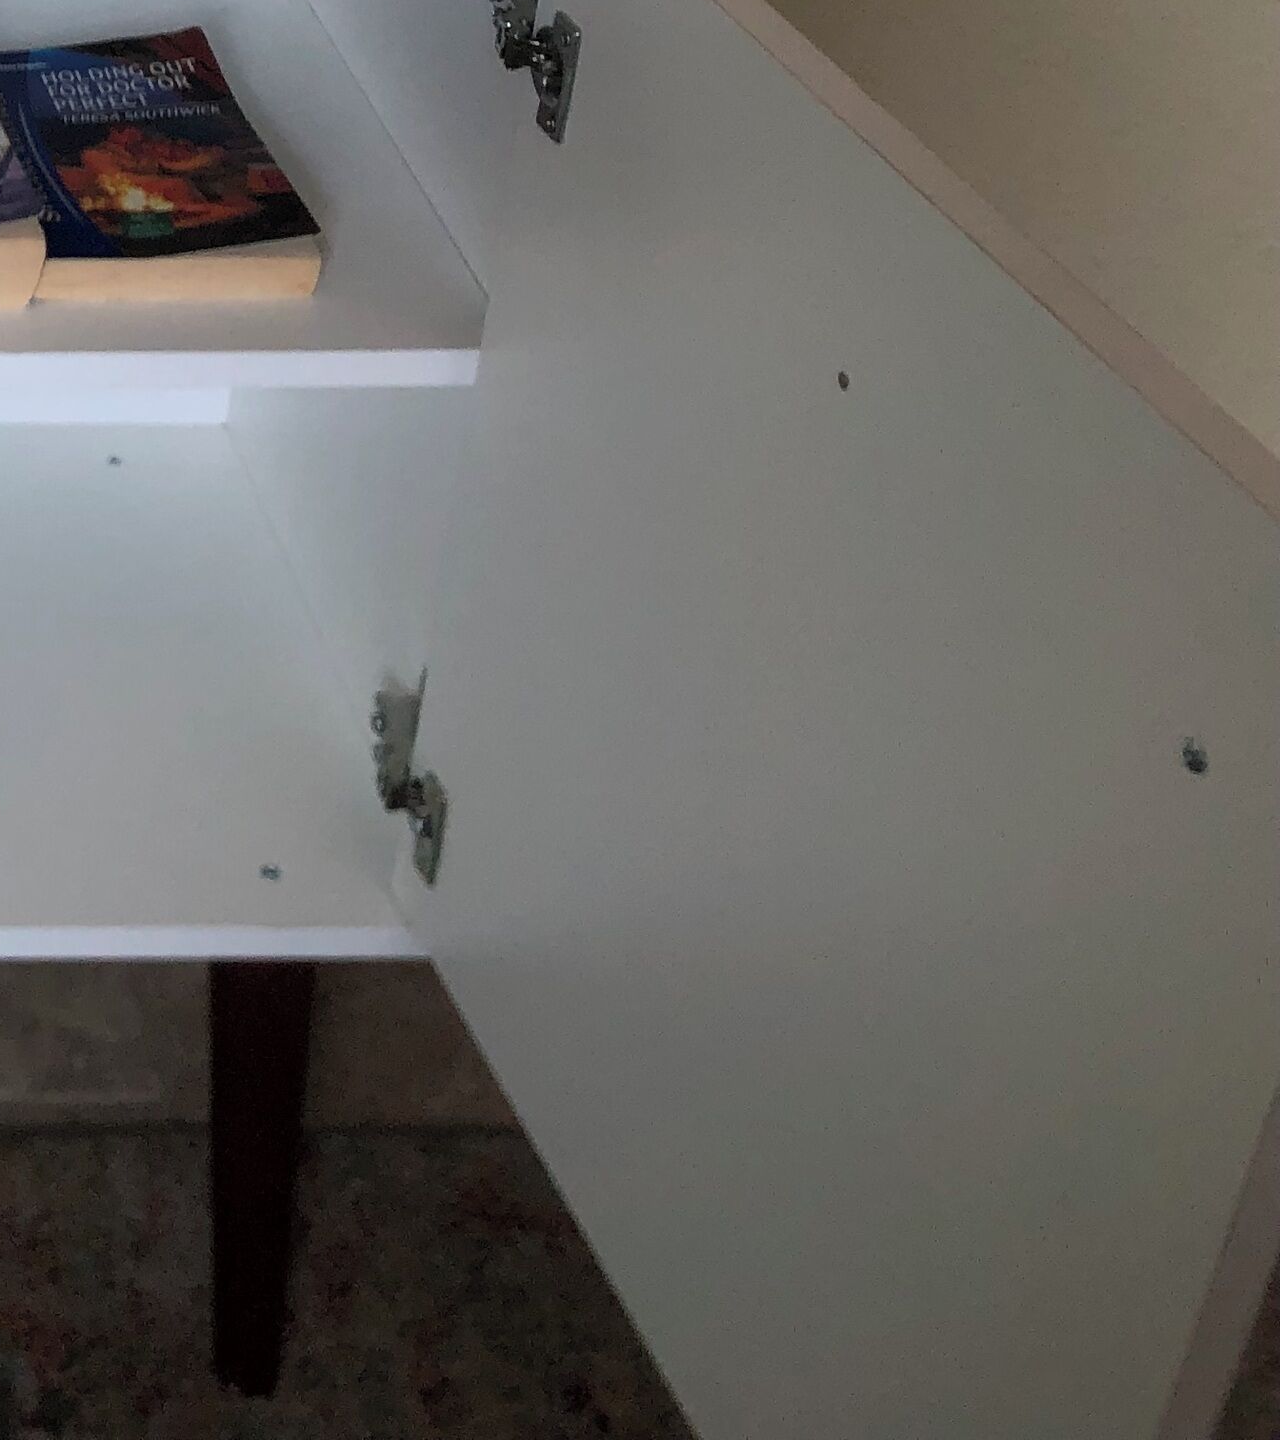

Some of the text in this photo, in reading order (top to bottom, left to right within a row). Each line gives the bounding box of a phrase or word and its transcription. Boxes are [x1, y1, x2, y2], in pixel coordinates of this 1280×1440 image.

[42, 62, 144, 85] HOLDING
[148, 57, 197, 76] OUT
[48, 74, 192, 97] FOR DOCTOR
[52, 90, 148, 112] PERFECT
